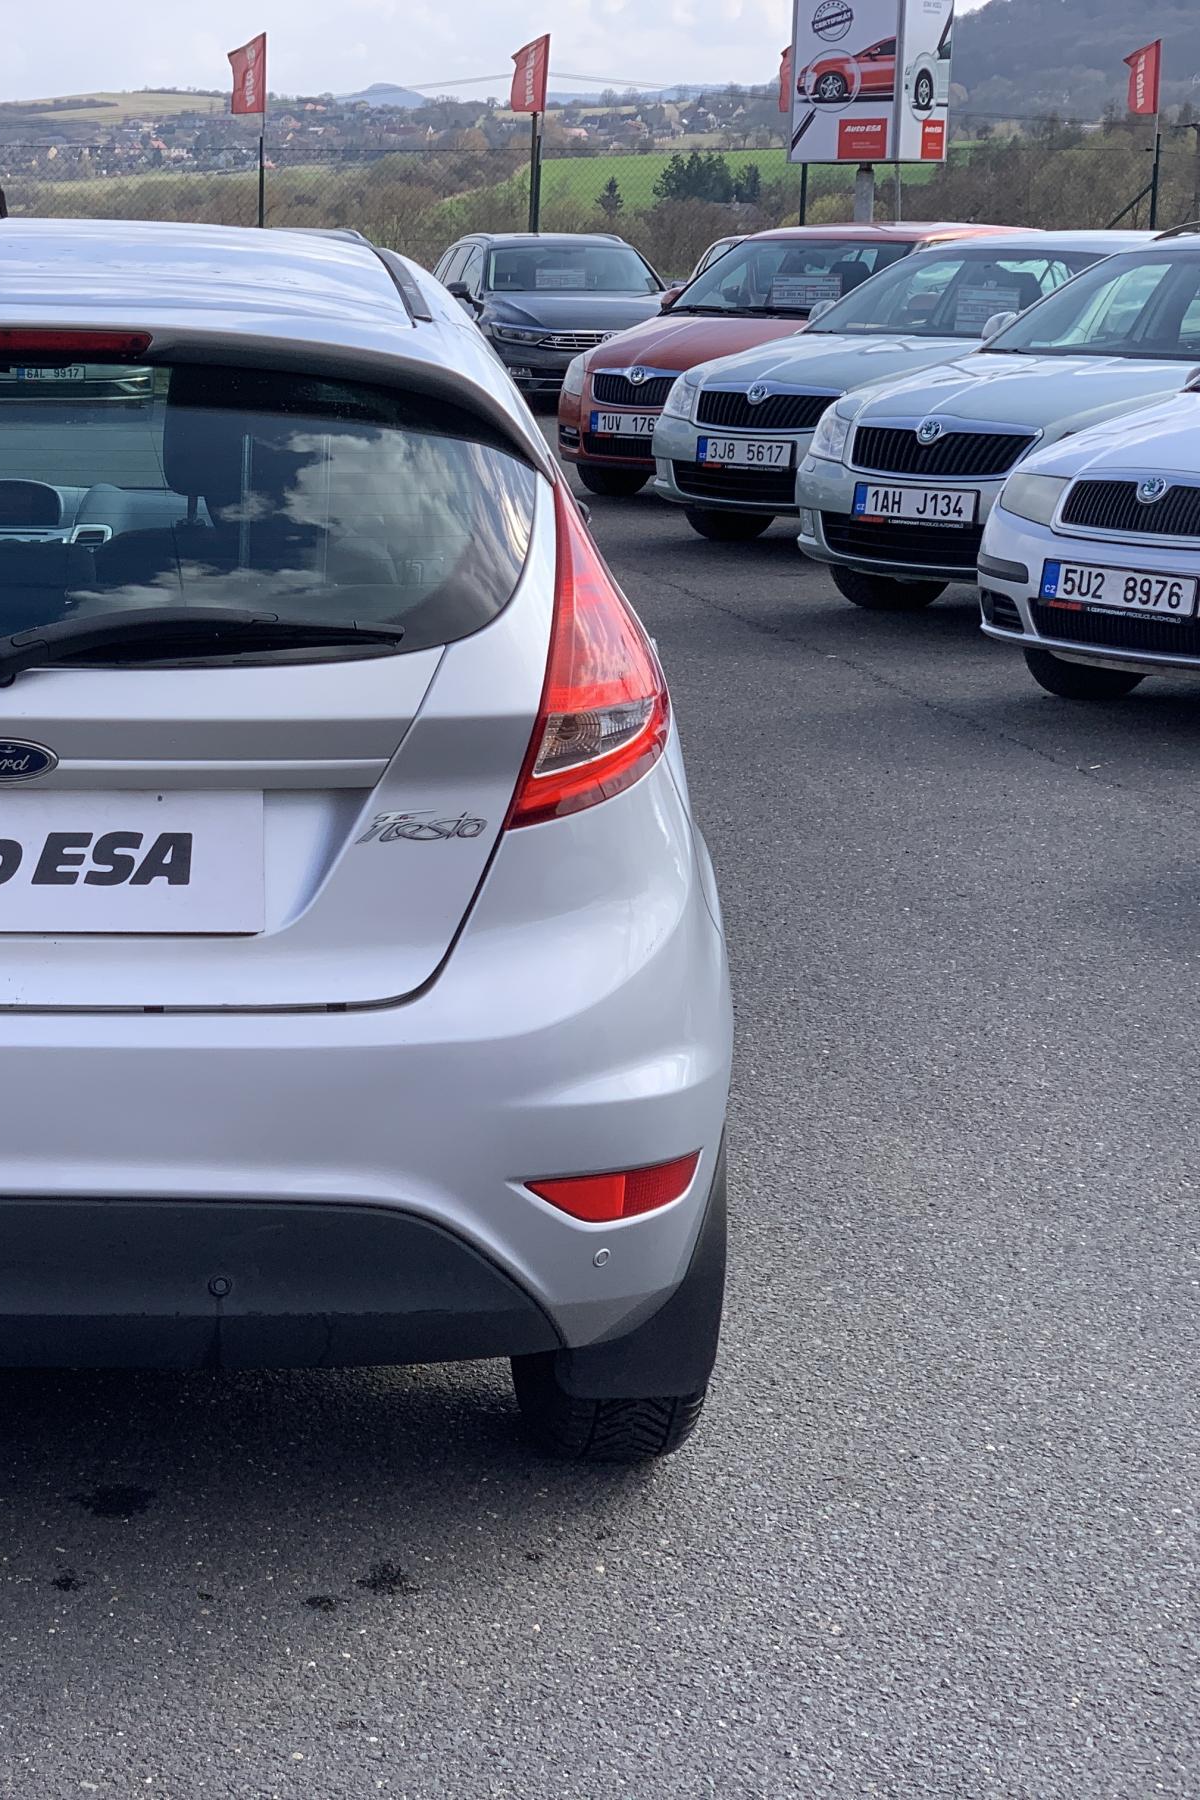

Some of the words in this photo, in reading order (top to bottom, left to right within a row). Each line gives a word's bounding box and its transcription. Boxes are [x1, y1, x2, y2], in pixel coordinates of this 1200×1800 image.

[602, 415, 621, 431] 1UV
[632, 416, 660, 432] 176
[709, 441, 735, 460] 3J8
[746, 443, 784, 463] 5617
[856, 503, 865, 511] CZ
[872, 489, 902, 513] 1AH
[916, 493, 963, 517] J134
[1044, 584, 1056, 594] CZ
[1062, 568, 1105, 600] 5U2
[1123, 576, 1183, 609] 8976
[355, 808, 489, 843] Fiesta
[31, 831, 193, 887] ESA
